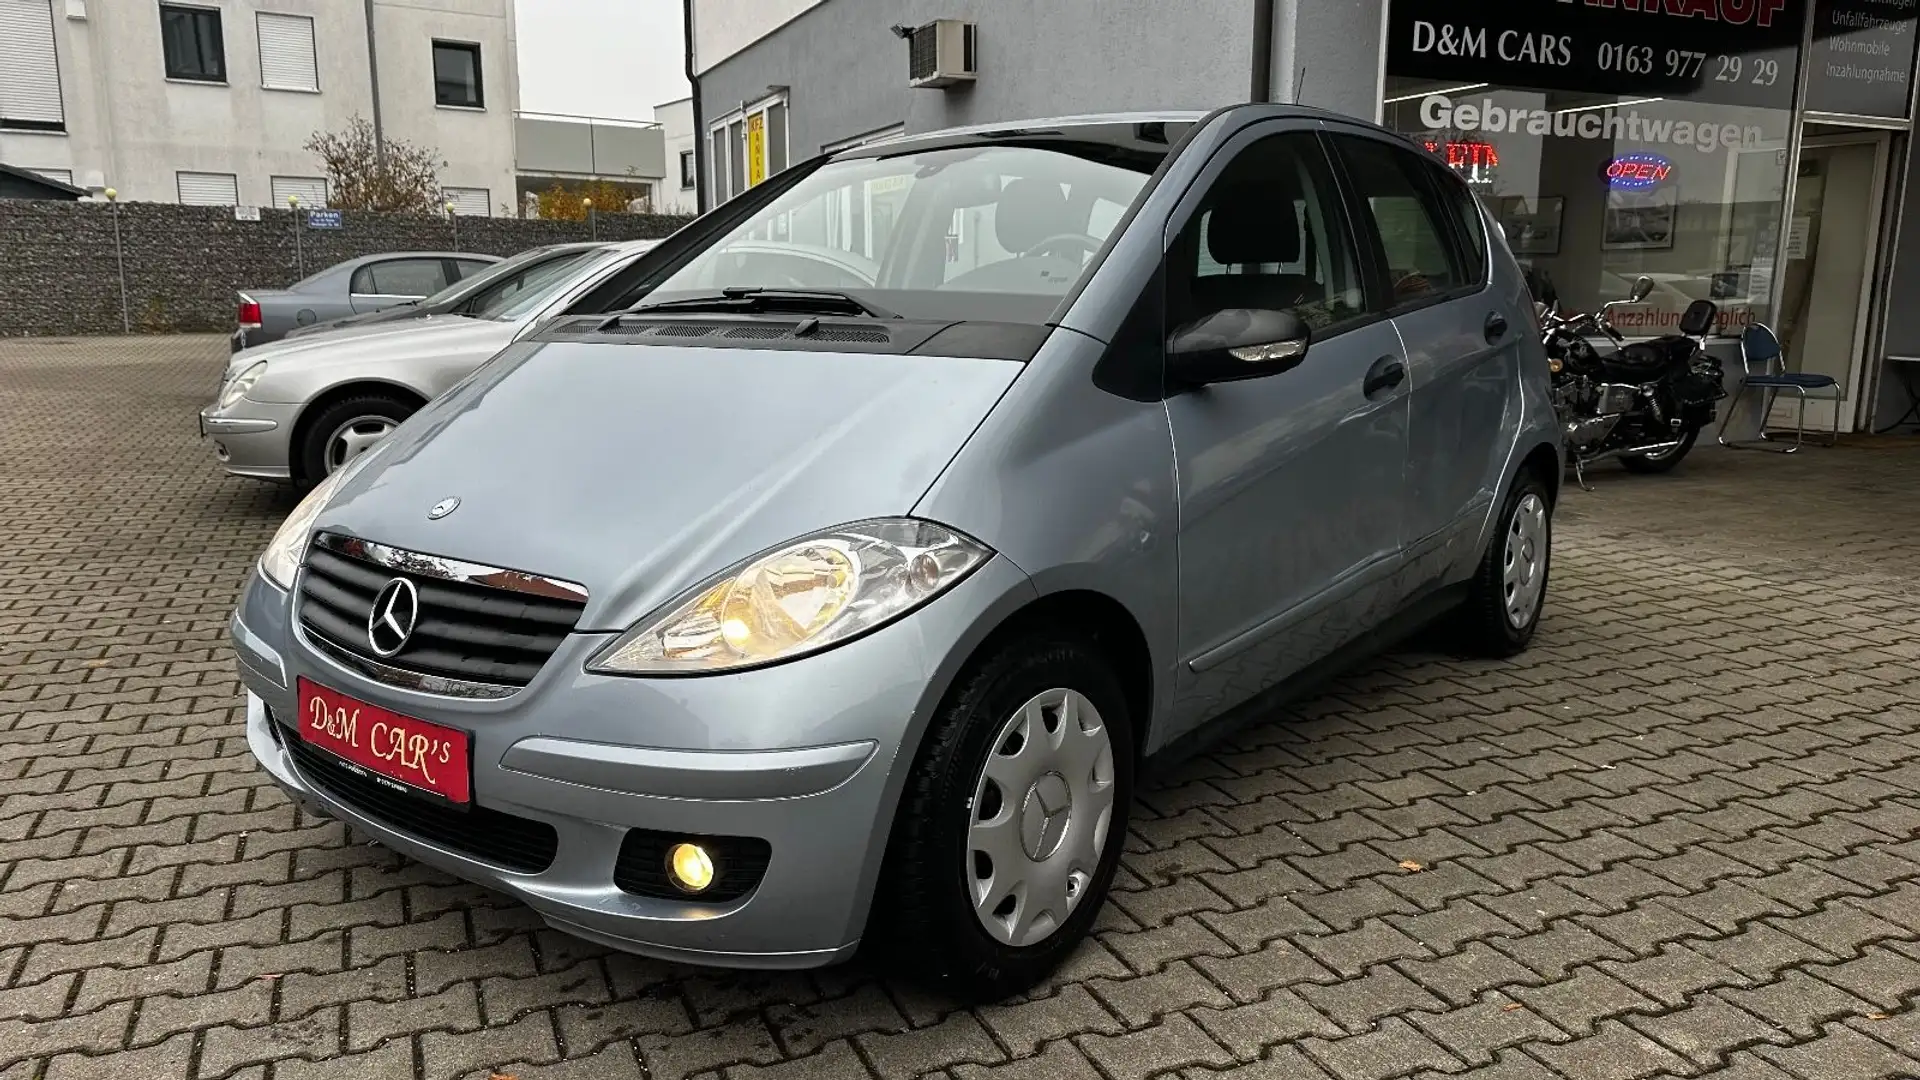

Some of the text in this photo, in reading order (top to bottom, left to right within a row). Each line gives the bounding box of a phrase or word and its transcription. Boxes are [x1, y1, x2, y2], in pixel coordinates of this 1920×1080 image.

[1832, 10, 1908, 35] Unfallfahrzeuge
[1412, 20, 1779, 86] D&M CARS 0163 977 29 29
[1829, 36, 1891, 56] Wohnmobile
[1826, 61, 1906, 84] Inzahlungnahme
[1418, 94, 1763, 153] Gebrauchtwagen
[1606, 161, 1672, 181] OPEN
[310, 210, 339, 218] Parken
[1607, 308, 1683, 328] Anzahlun
[309, 696, 452, 785] D&M CAR'S
